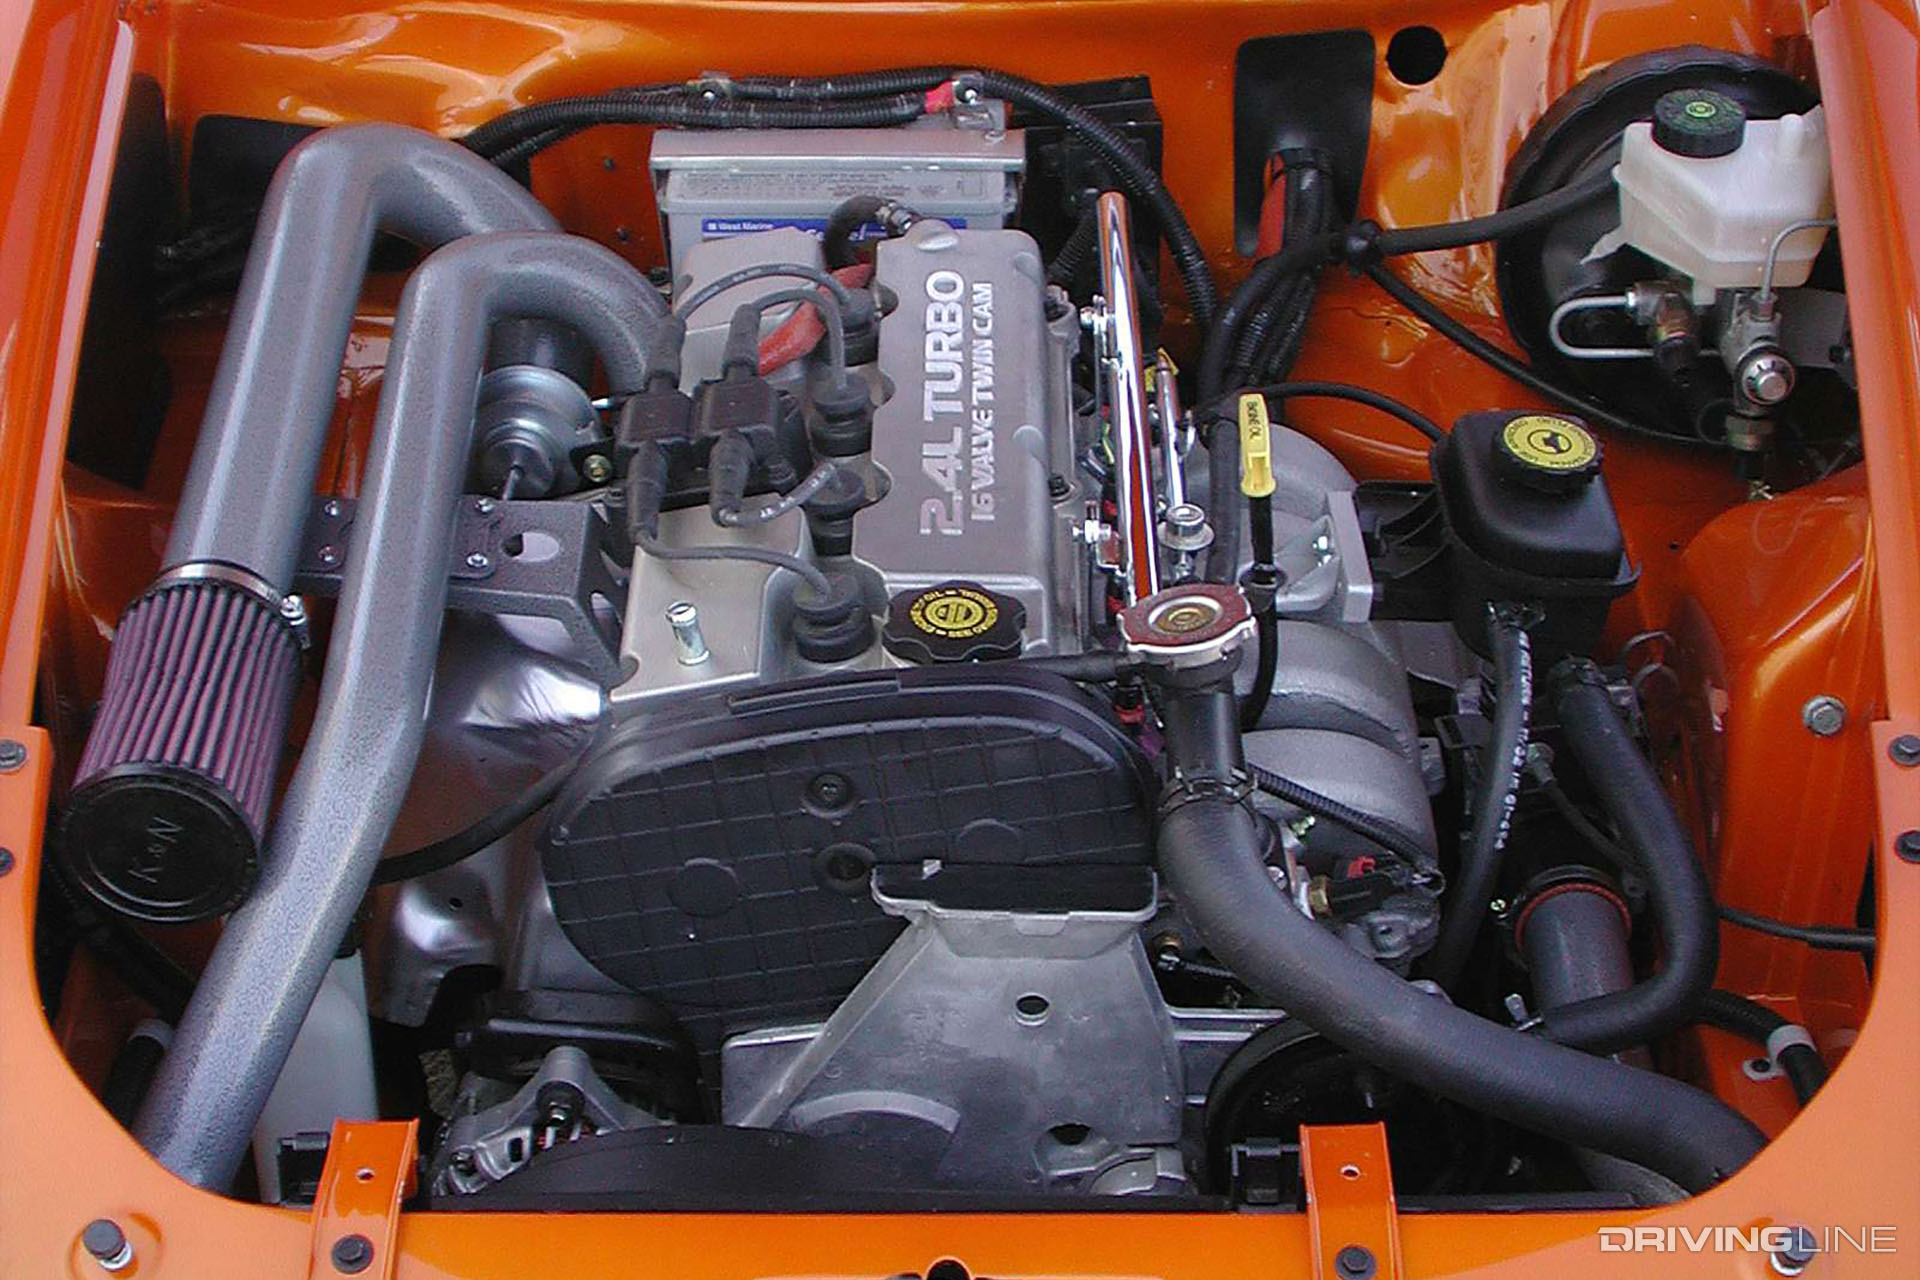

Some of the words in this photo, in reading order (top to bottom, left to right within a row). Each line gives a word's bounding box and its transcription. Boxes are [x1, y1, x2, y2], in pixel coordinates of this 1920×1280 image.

[971, 282, 993, 333] CAM
[923, 270, 965, 422] TURBO
[971, 339, 995, 406] TWIN
[920, 427, 964, 536] 2.4L
[970, 408, 995, 491] VALVE
[970, 494, 995, 521] 16
